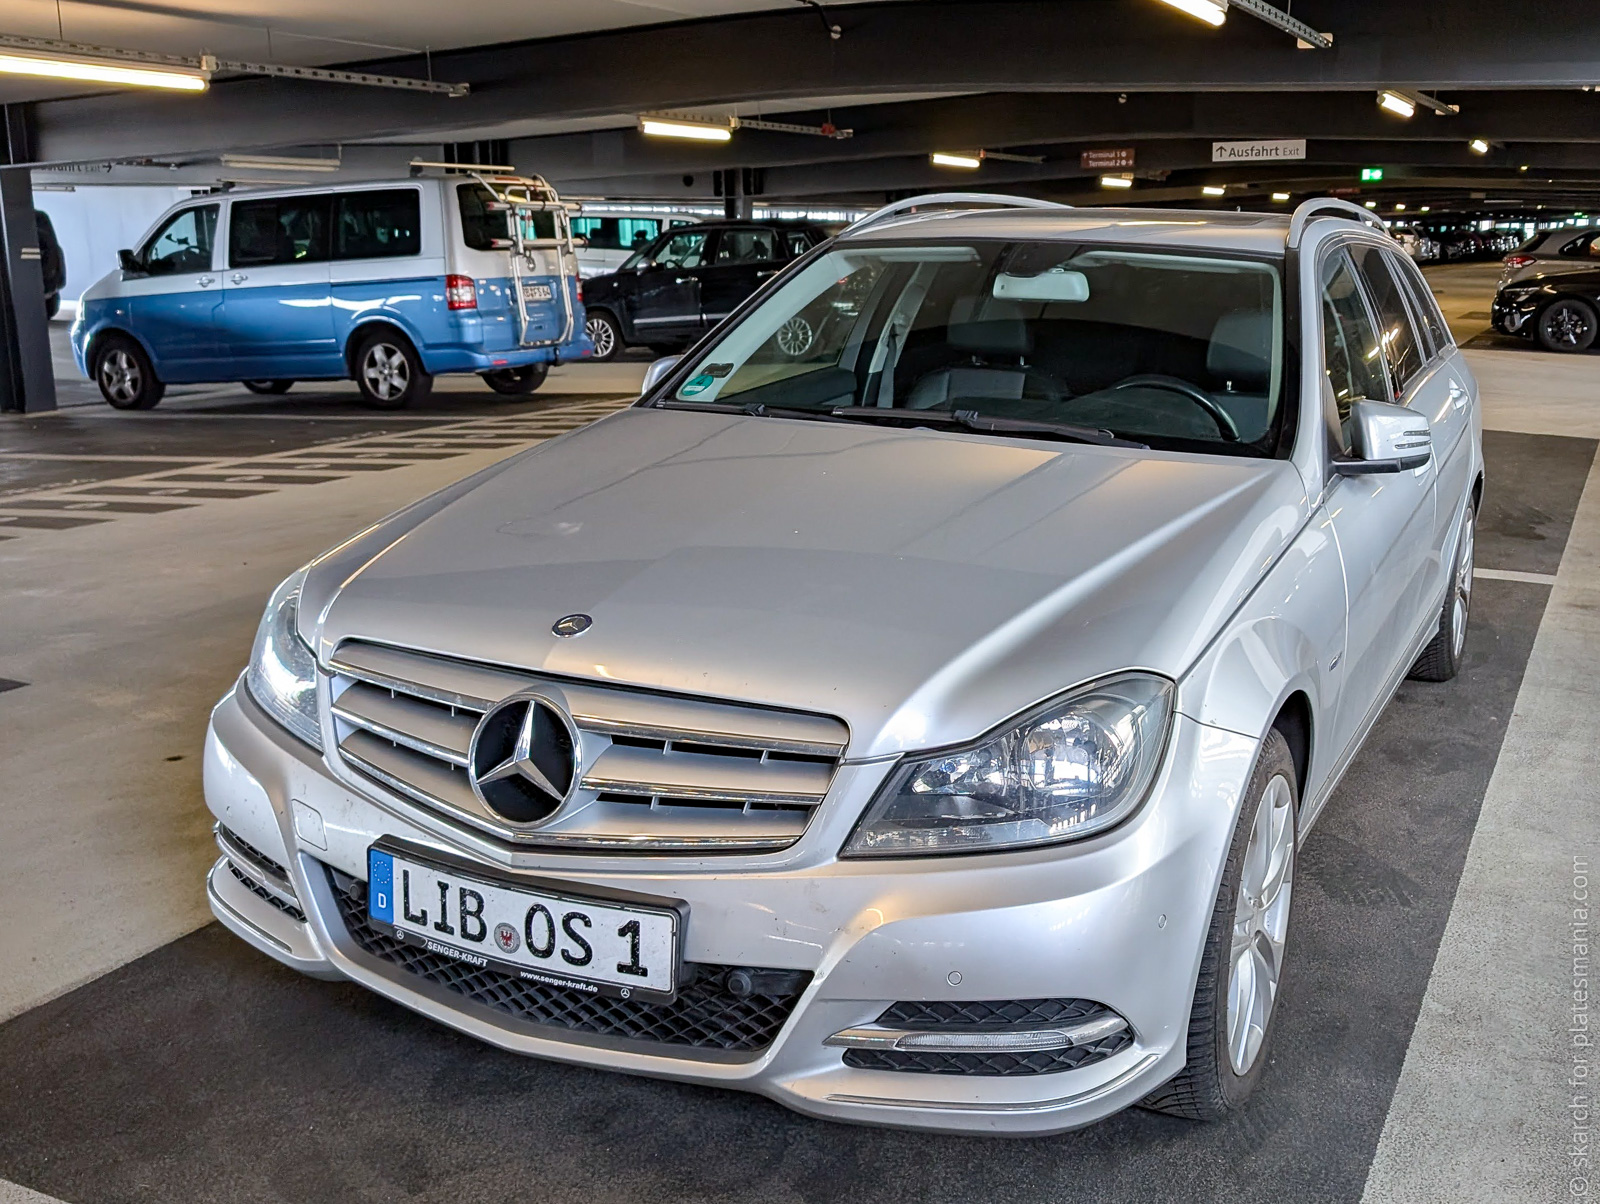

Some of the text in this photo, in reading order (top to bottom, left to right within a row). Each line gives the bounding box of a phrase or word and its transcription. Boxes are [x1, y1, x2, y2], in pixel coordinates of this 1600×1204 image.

[1088, 150, 1115, 158] Terminal
[1228, 145, 1300, 158] Ausfahrt Exit
[378, 892, 387, 908] D
[402, 869, 649, 977] LIB OS 1
[427, 941, 488, 966] SENGER-KRAFT
[520, 970, 599, 993] www.senger-kraft.de
